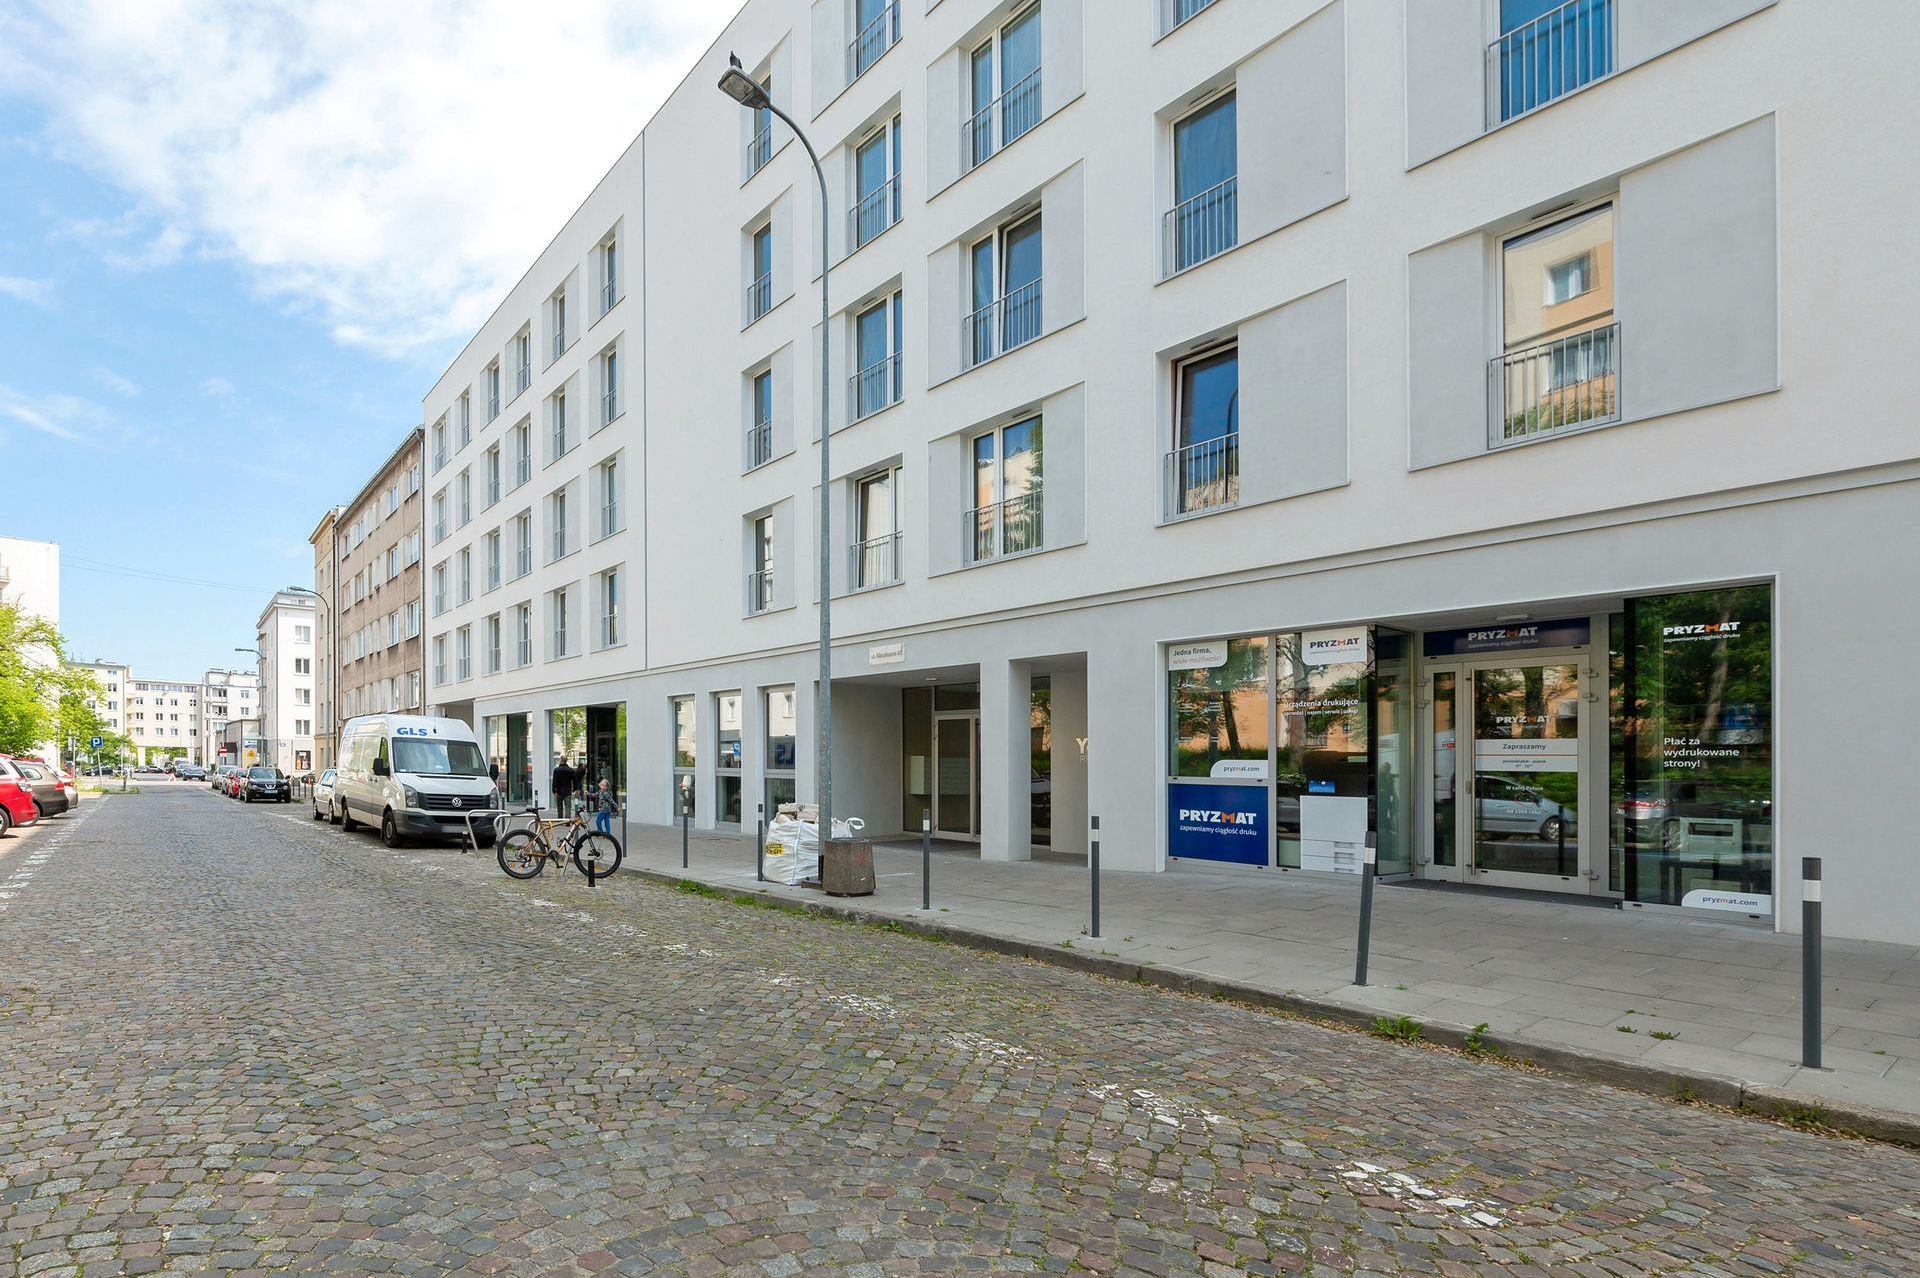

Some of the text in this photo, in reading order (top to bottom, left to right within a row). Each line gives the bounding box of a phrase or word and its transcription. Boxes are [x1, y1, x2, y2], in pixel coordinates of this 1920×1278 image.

[1468, 626, 1538, 641] PRYZMAT
[1664, 621, 1741, 636] PRYZMAT
[1310, 637, 1360, 649] PRYZMAT
[1173, 647, 1211, 656] Jedna firma,
[1496, 715, 1552, 724] PRYZMAT
[396, 727, 428, 737] GLS
[1664, 736, 1701, 746] Płać za
[1502, 743, 1547, 751] Zapraszamy
[1663, 748, 1740, 758] wydrukowane
[1663, 760, 1701, 770] strony!
[1179, 809, 1257, 825] PRYZMAT
[1180, 825, 1257, 836] zapewniamy ciągłość druku
[1702, 896, 1758, 907] pryzmat.com
